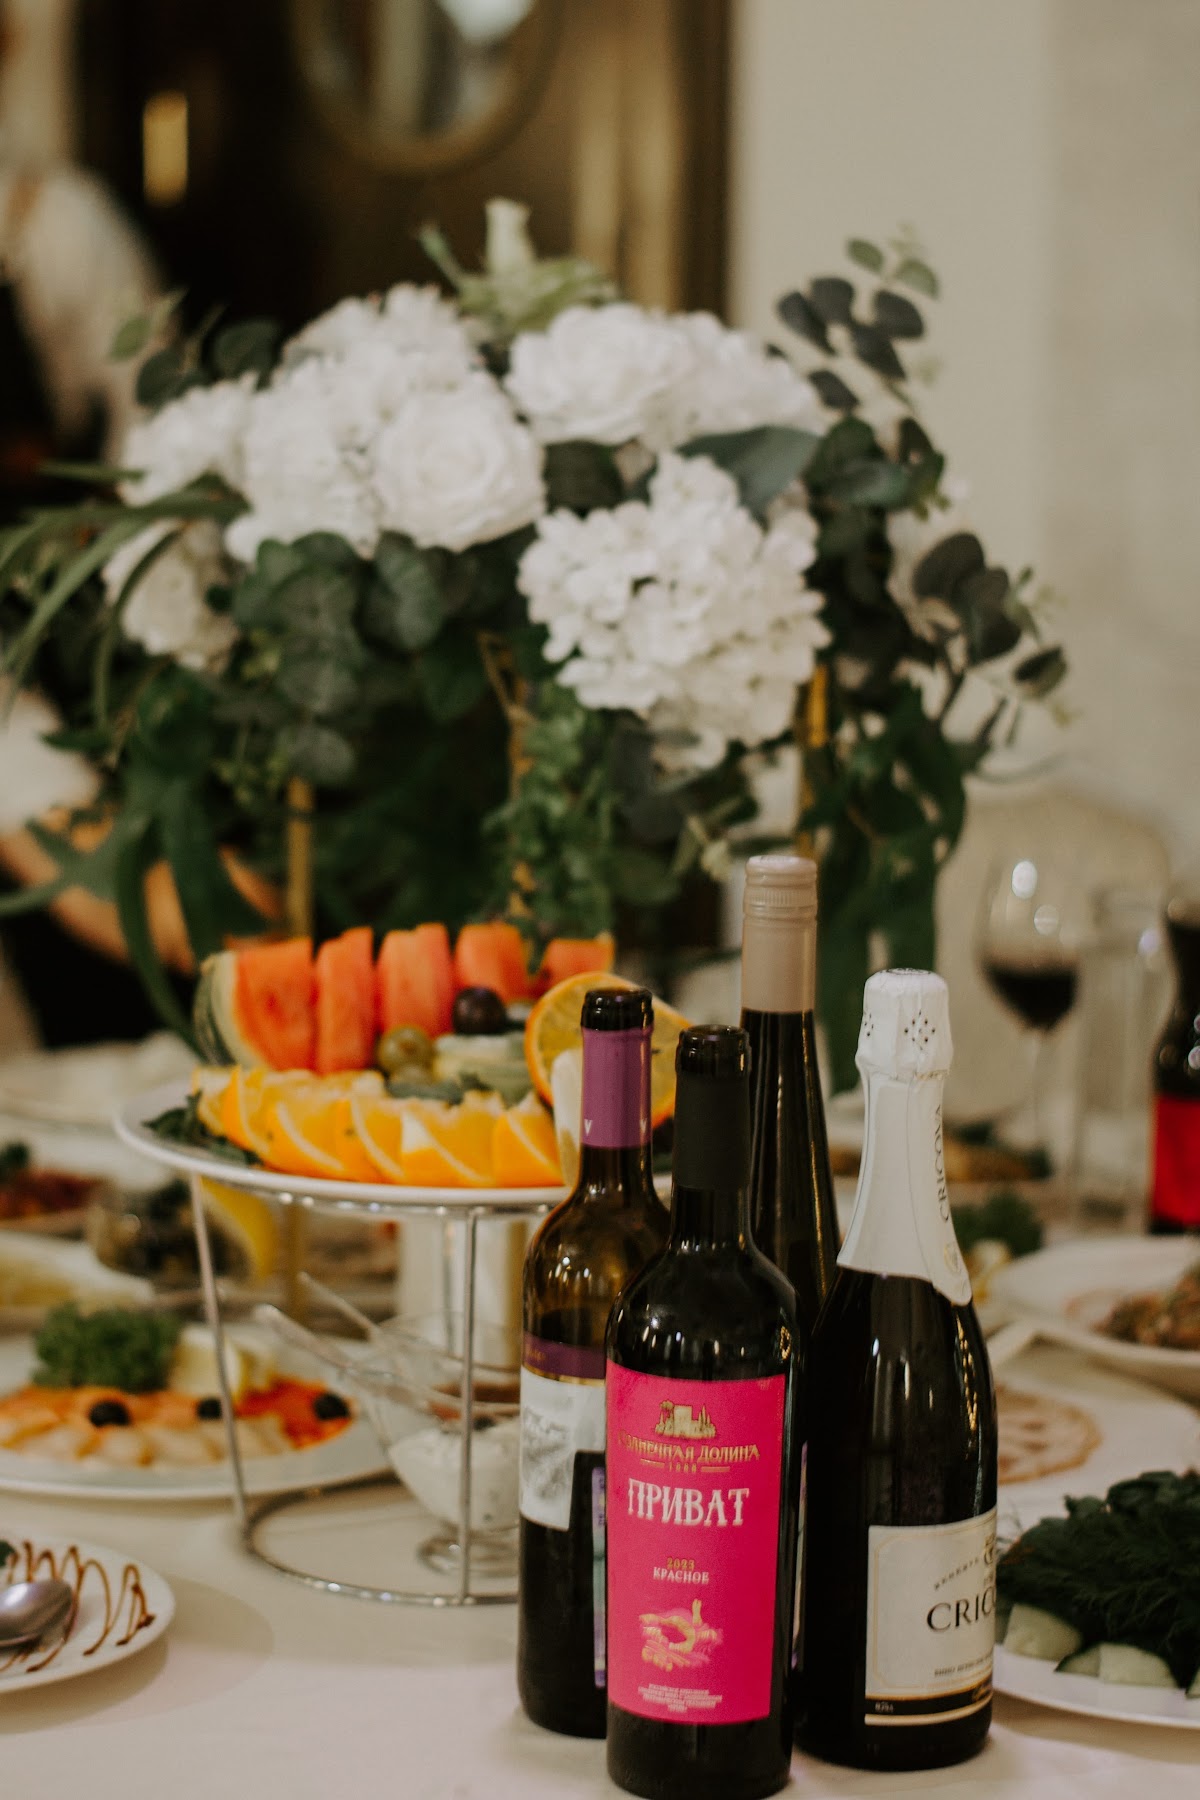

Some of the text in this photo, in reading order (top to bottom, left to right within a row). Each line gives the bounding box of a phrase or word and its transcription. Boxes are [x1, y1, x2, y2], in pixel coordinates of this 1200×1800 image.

[584, 1118, 592, 1136] V
[696, 1443, 761, 1465] ДОЛИНА
[627, 1477, 750, 1527] ПРИВАТ
[652, 1566, 710, 1585] КРАСНОЕ
